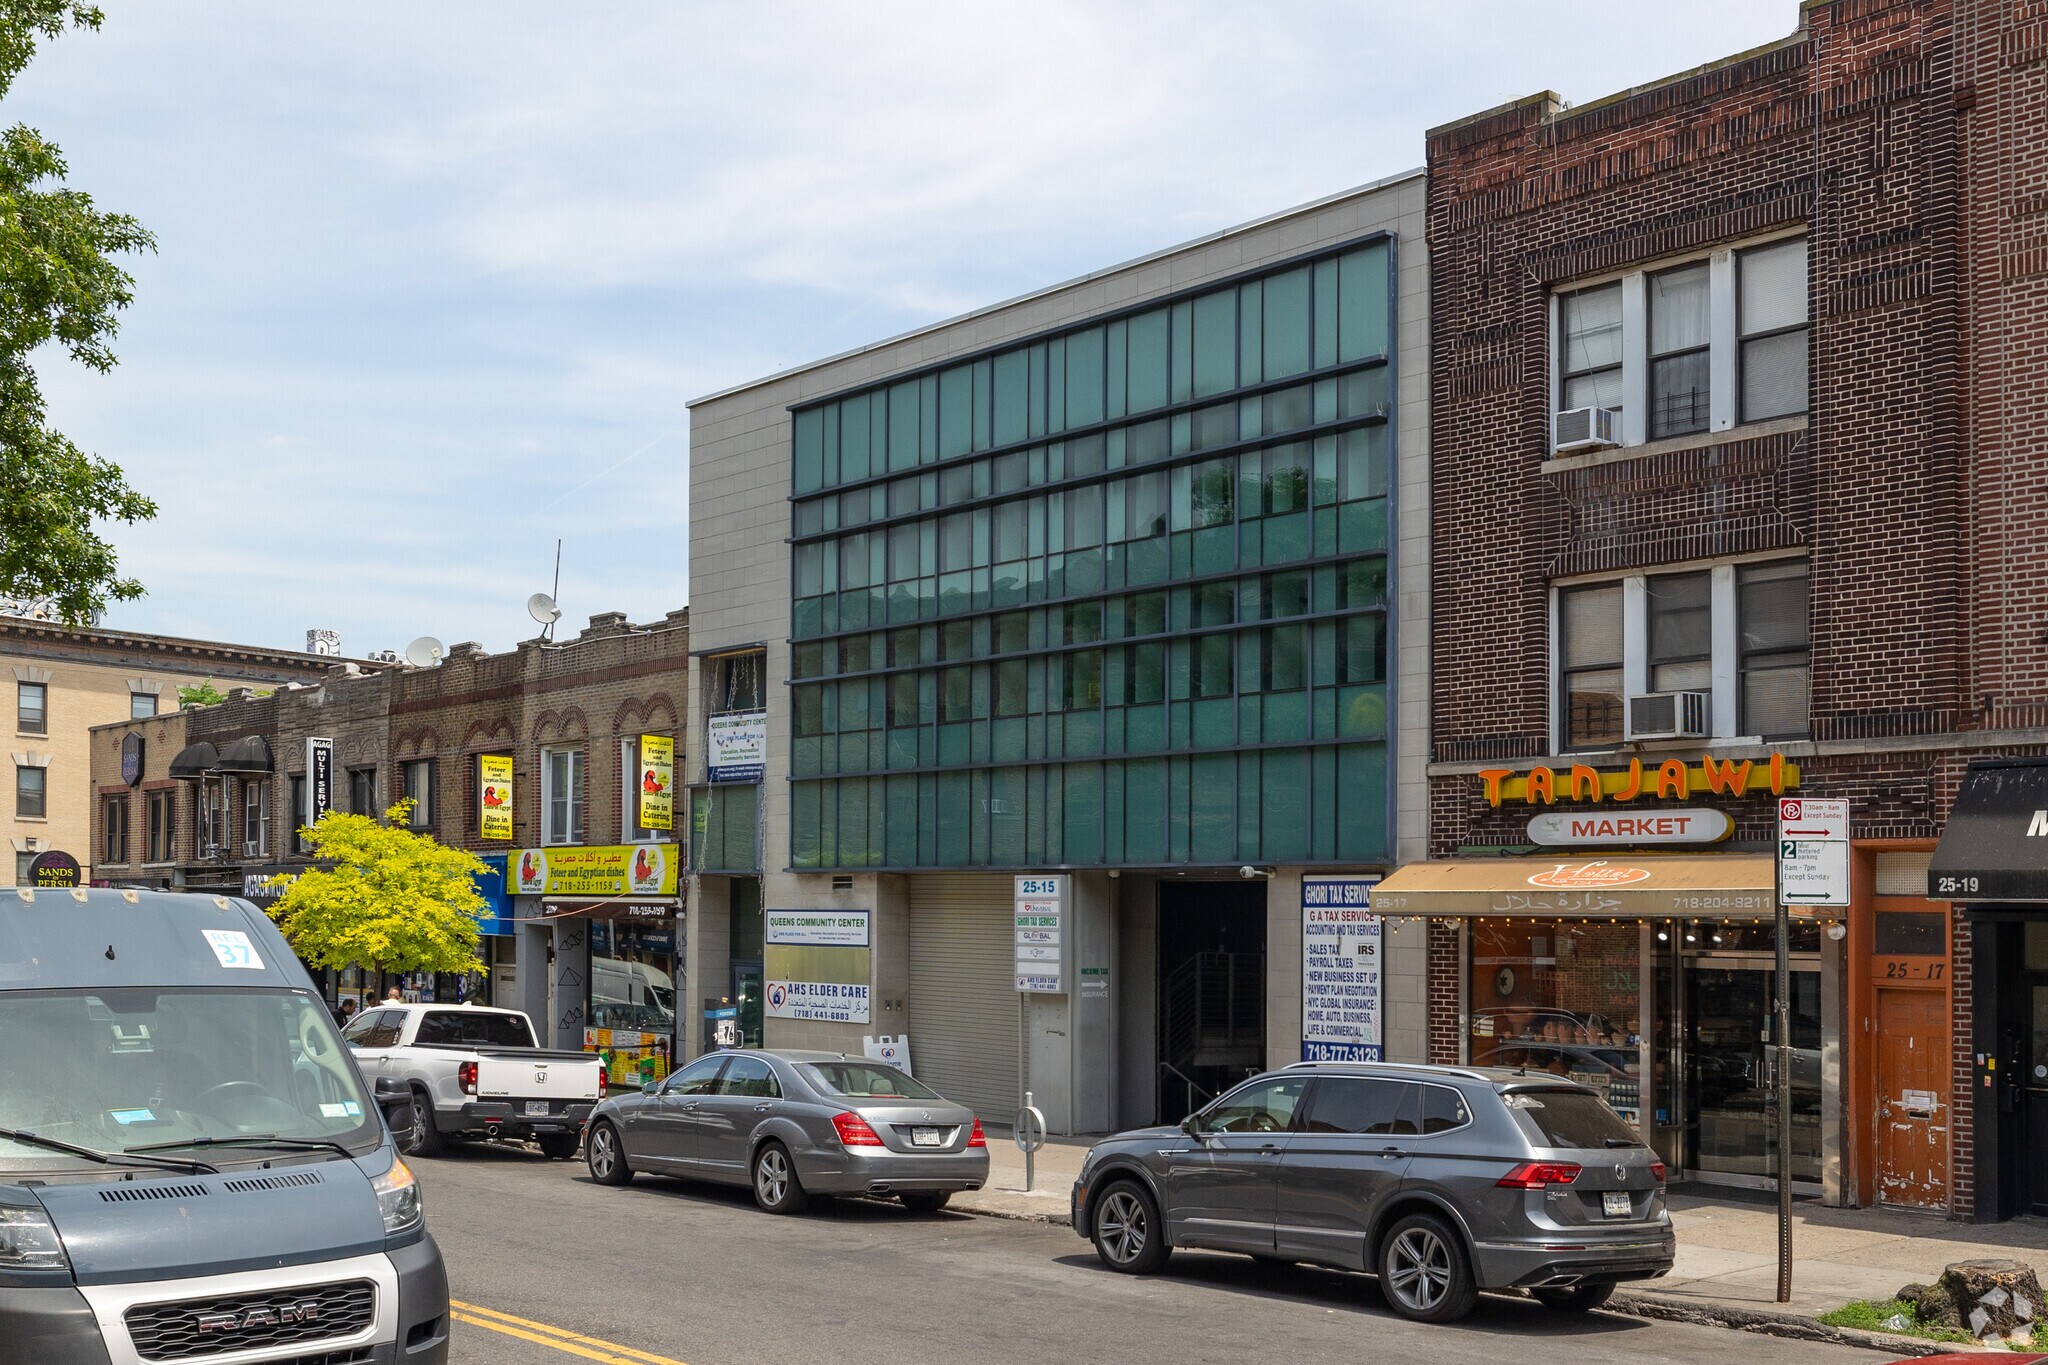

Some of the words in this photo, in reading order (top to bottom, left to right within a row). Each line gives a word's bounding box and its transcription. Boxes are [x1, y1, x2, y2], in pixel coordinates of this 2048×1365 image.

[712, 721, 728, 729] QUEENS
[648, 747, 667, 755] Feteer
[1478, 752, 1787, 808] TANJAWI
[318, 781, 326, 820] SERVIC
[646, 802, 660, 811] Dine
[644, 811, 670, 822] Catering
[1823, 812, 1842, 820] Sunday
[484, 823, 510, 832] Catering
[1571, 816, 1692, 838] MARKET
[1784, 842, 1794, 858] 2
[39, 868, 74, 877] SANDS
[550, 868, 567, 878] Feteer
[568, 868, 578, 877] and
[580, 867, 605, 880] Egyptian
[606, 866, 625, 876] dishes
[38, 880, 73, 888] PERSIA
[560, 881, 612, 890] 718-255-1159
[1023, 881, 1055, 893] 25-15
[1938, 877, 1979, 892] 25-19
[1306, 885, 1327, 904] GHORI
[1329, 885, 1343, 904] TAX
[1344, 884, 1375, 904] SERVIC
[1376, 898, 1407, 908] 25-17
[1492, 894, 1553, 911] حلال
[1673, 896, 1770, 909] 718-204-8211
[1038, 917, 1057, 926] SERVICES
[1310, 911, 1315, 922] G
[1318, 911, 1322, 922] A
[1325, 911, 1339, 922] TAX
[1342, 911, 1374, 922] SERVICE
[770, 918, 795, 927] QUEENS
[797, 918, 836, 927] COMMUNITY
[838, 918, 865, 928] CENTER
[1306, 924, 1335, 935] ACCOUNTING
[1336, 924, 1346, 935] AND
[1347, 925, 1356, 935] TAX
[1357, 925, 1380, 936] SERVICES
[211, 933, 244, 943] REL
[217, 944, 250, 964] 37
[1309, 944, 1327, 955] SALES
[1328, 944, 1340, 955] TAX
[1358, 945, 1375, 955] IRS
[1309, 957, 1334, 968] PAYROLL
[1335, 958, 1353, 968] TAXES
[1605, 956, 1639, 966] HALA
[1309, 971, 1323, 981] NEW
[1324, 972, 1354, 982] BUSINESS
[1356, 972, 1367, 983] SET
[1369, 972, 1377, 983] UP
[788, 983, 806, 995] AHS
[809, 984, 838, 997] ELDER
[842, 986, 867, 998] CARE
[1308, 984, 1330, 995] PAYMENT
[1331, 985, 1344, 995] PLAN
[1345, 985, 1377, 996] NEGOTIATION
[1308, 997, 1319, 1008] NYC
[1320, 998, 1341, 1009] GLOBAL
[1342, 998, 1376, 1010] INSURANCE:
[794, 1010, 812, 1018] (718)
[814, 1011, 849, 1020] 441-6803
[1308, 1010, 1325, 1023] HOME,
[1326, 1011, 1342, 1024] AUTO,
[1343, 1012, 1372, 1025] BUSINESS,
[1308, 1024, 1319, 1035] LIFE
[1321, 1025, 1325, 1035] &
[1326, 1025, 1363, 1037] COMMERCIAL.
[1308, 1045, 1378, 1062] 718-777-3129
[196, 1300, 318, 1334] RAM
